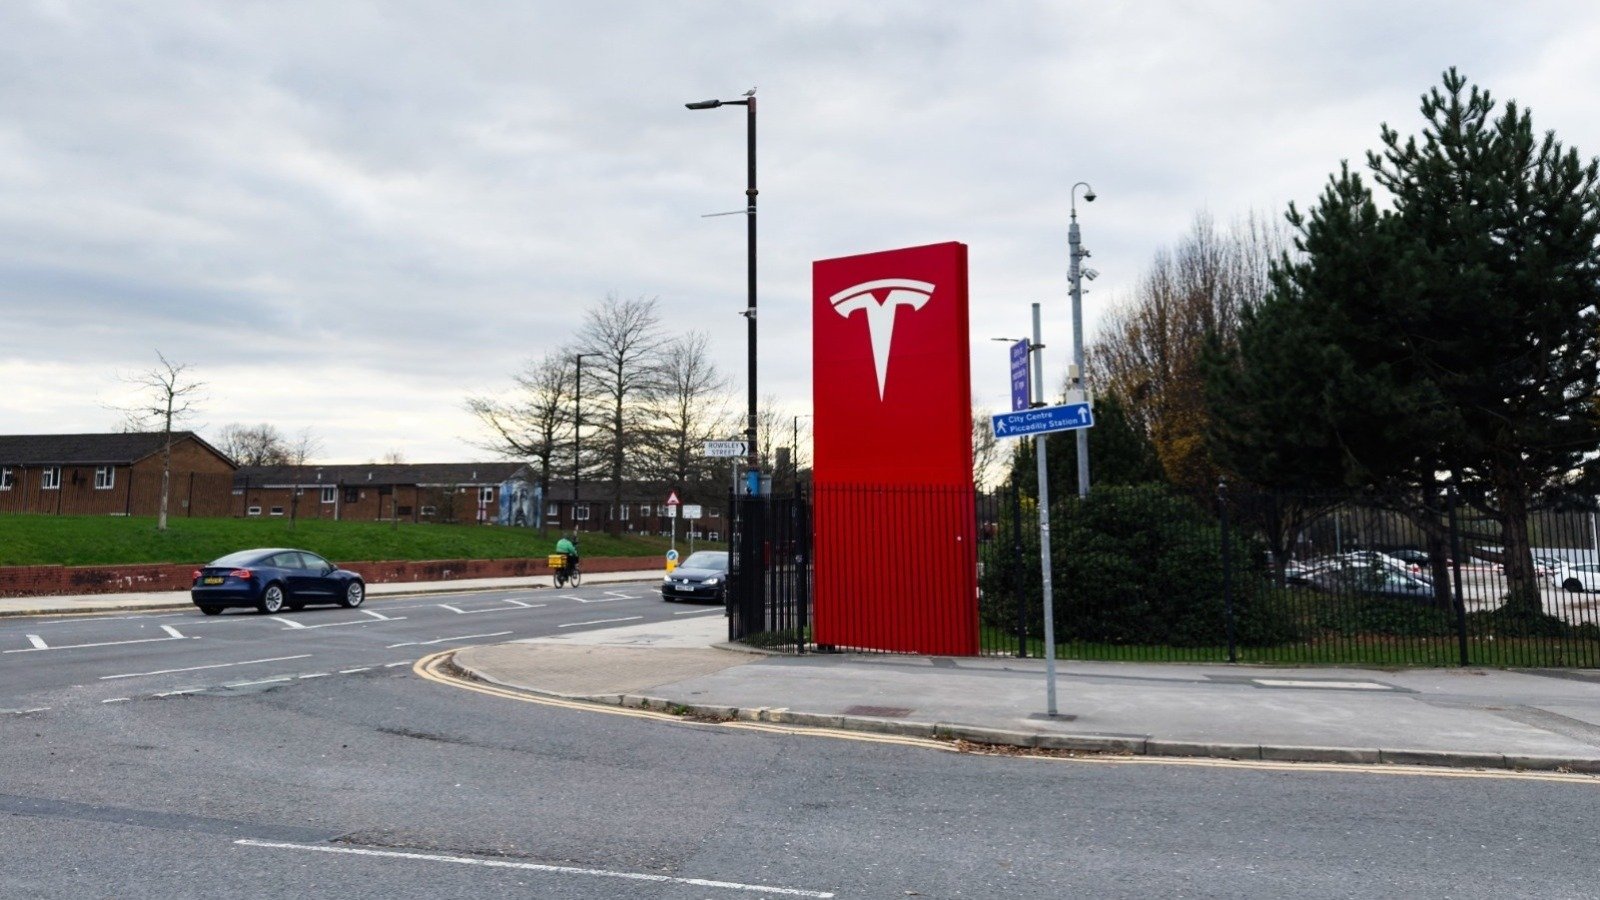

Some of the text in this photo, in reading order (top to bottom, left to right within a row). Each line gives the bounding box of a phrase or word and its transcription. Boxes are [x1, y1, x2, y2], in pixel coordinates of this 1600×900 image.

[1008, 412, 1053, 424] City Centre
[1010, 418, 1078, 433] Piccadilly Station
